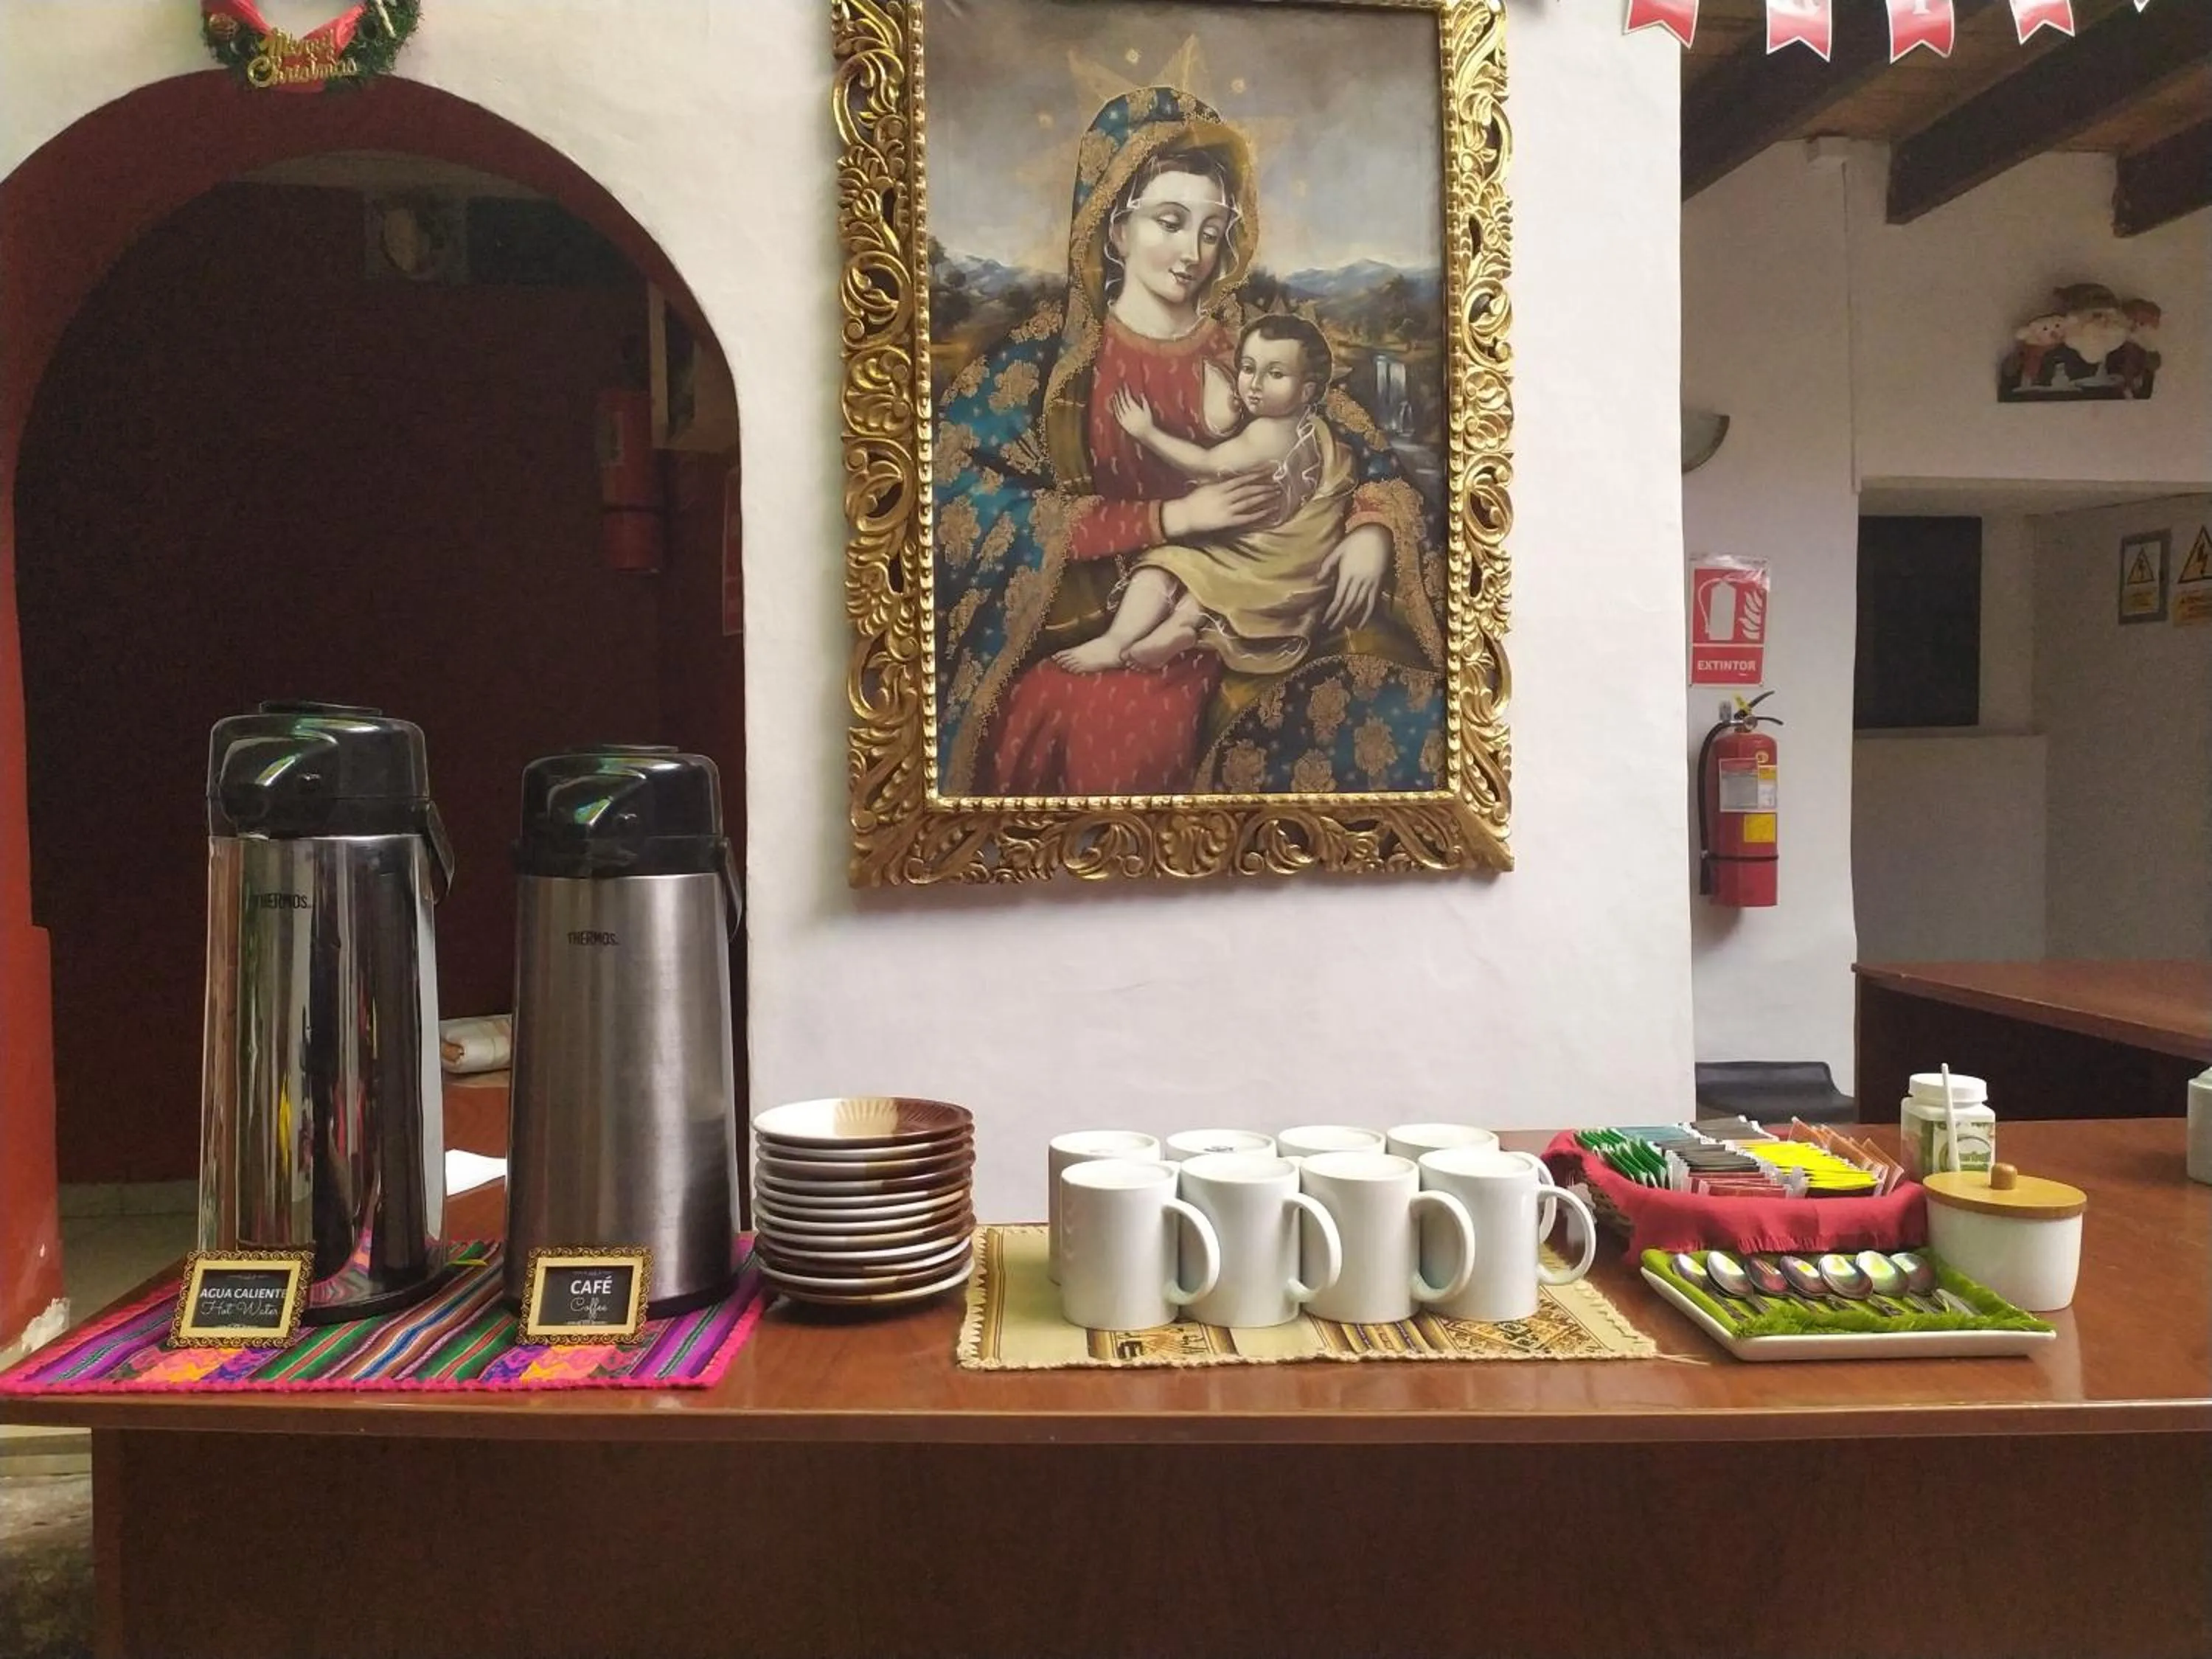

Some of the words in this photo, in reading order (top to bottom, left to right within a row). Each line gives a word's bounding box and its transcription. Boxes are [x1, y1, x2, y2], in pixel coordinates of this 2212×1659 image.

[1697, 660, 1756, 671] EXTINTOR
[200, 1288, 232, 1298] AGUA
[234, 1288, 287, 1298] CALIENTE
[570, 1275, 613, 1295] CAFÉ
[200, 1300, 234, 1315] Hot
[237, 1299, 278, 1316] Water
[570, 1297, 608, 1320] Coffee
